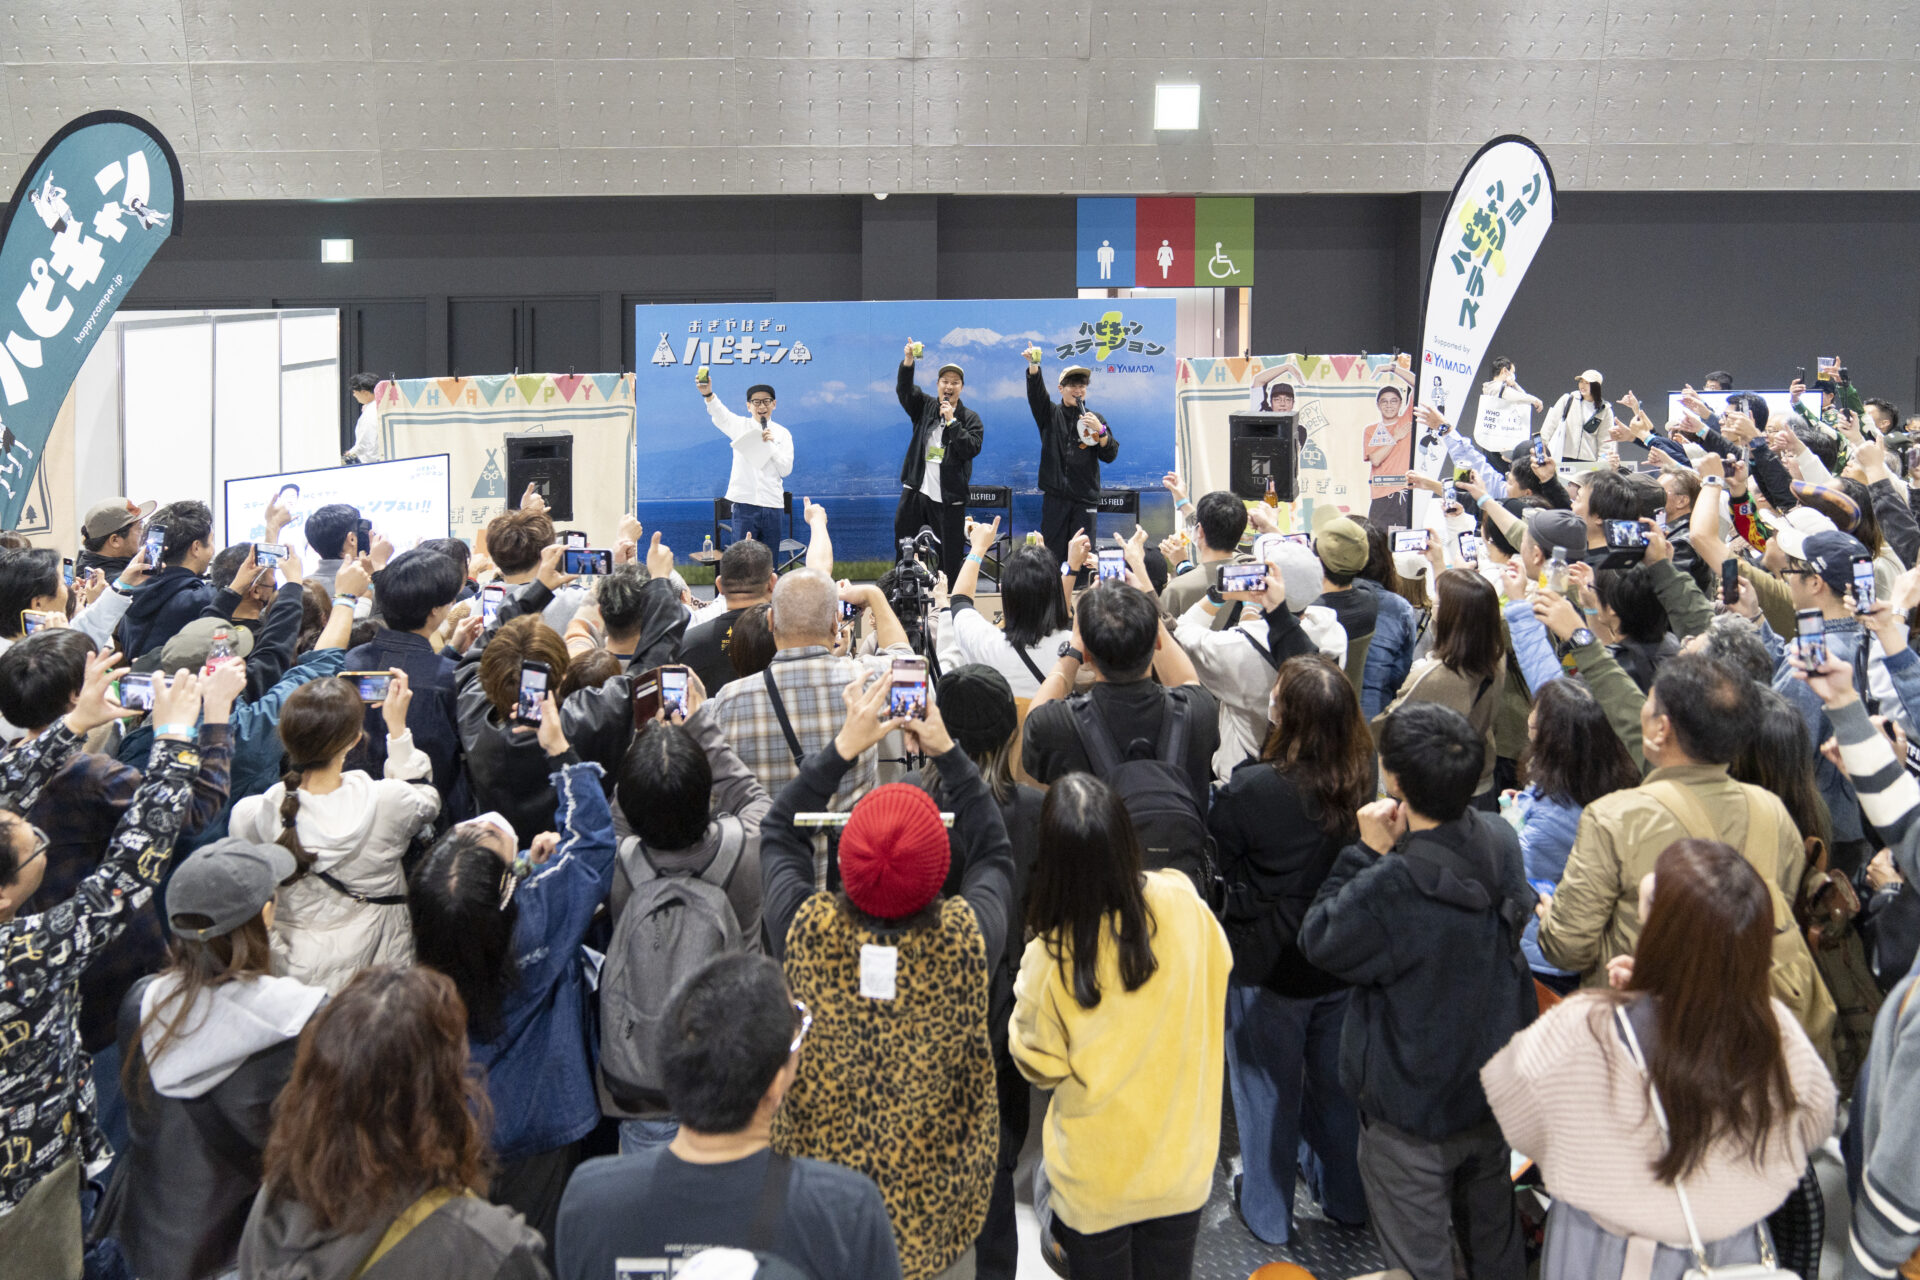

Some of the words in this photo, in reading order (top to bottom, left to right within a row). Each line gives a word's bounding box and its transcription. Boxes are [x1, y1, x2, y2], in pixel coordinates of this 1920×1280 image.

[1450, 179, 1504, 275] ハピキャン
[1458, 172, 1542, 330] ステーション
[73, 274, 124, 345] happycamper.jp
[688, 317, 787, 333] おぎやはぎの
[1078, 320, 1144, 336] ハピキャン
[682, 335, 789, 365] ハピキャン
[1055, 337, 1166, 360] ステーション
[1434, 335, 1462, 352] Supported
[1116, 364, 1155, 374] YAMADA
[1434, 353, 1473, 376] YAMADA
[426, 384, 594, 406] HAPPY
[1484, 415, 1496, 423] ARE
[1485, 409, 1501, 417] WHO
[980, 493, 996, 501] FIELD
[1108, 498, 1124, 506] FIELD
